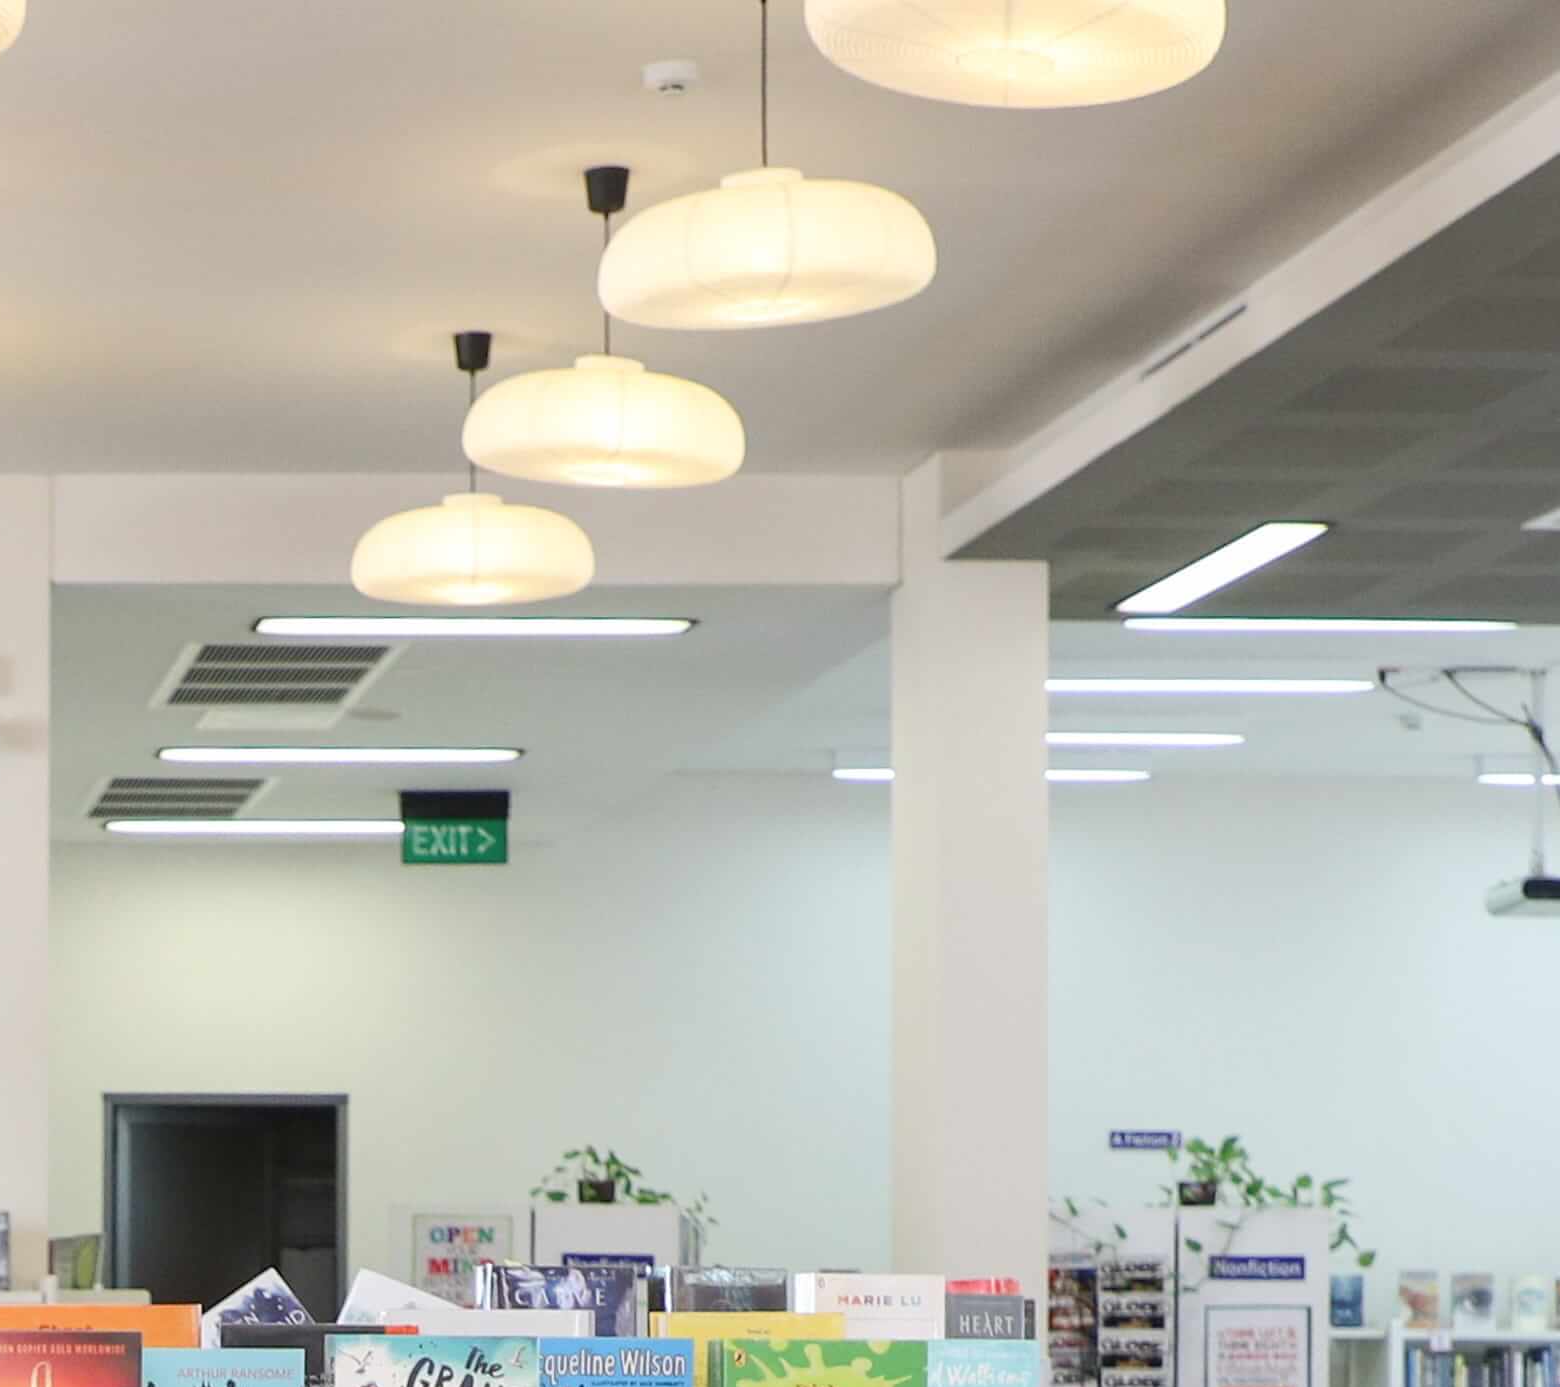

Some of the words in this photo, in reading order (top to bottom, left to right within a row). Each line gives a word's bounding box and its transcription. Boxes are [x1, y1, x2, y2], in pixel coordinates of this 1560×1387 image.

[412, 826, 469, 855] EXIT
[430, 1227, 494, 1243] OPEN
[1215, 1259, 1302, 1276] Nonfiction
[836, 1294, 892, 1306] MARIE
[898, 1294, 922, 1306] LU
[959, 1311, 1014, 1336] HEART
[464, 1347, 505, 1380] The
[176, 1366, 227, 1380] ARTHUR
[230, 1366, 296, 1380] RANSOME
